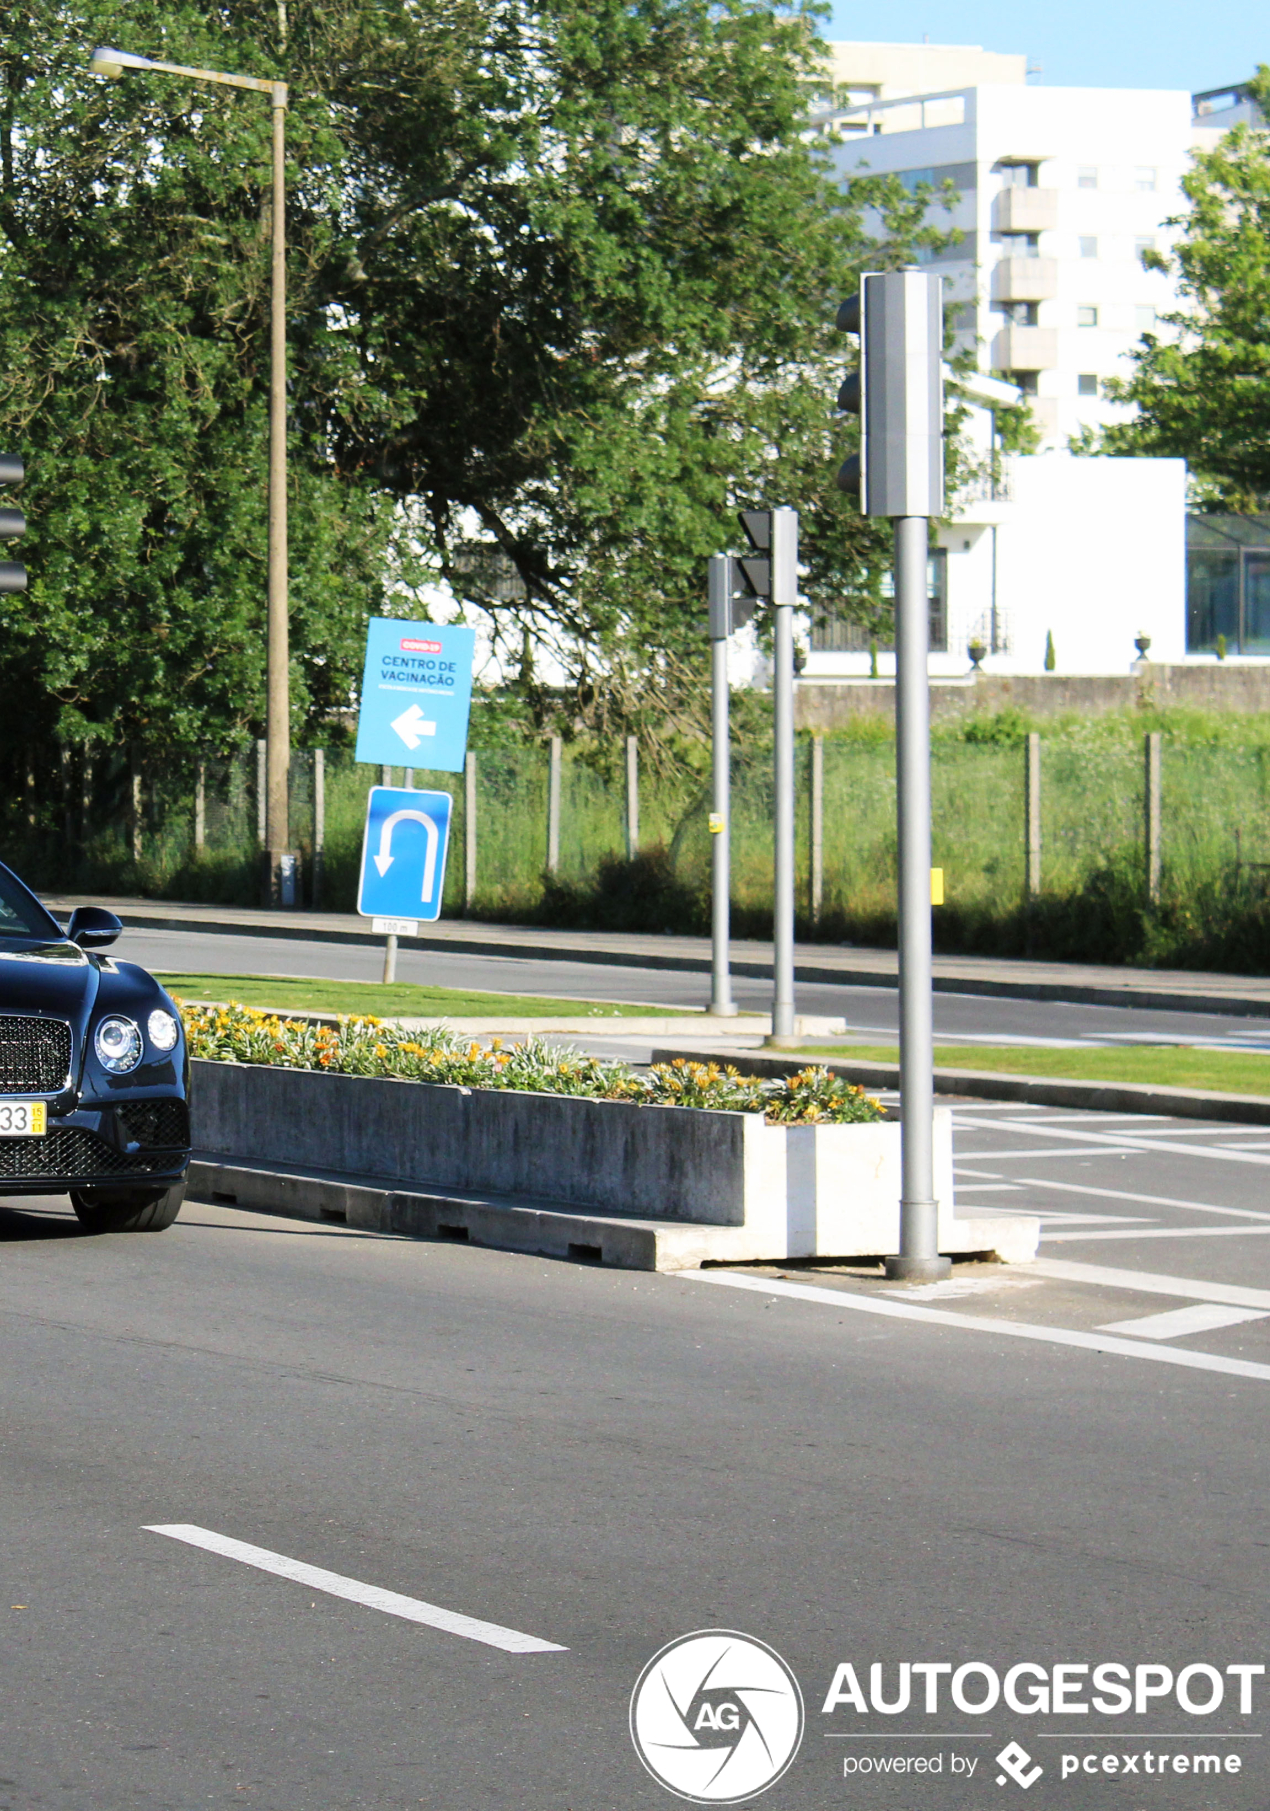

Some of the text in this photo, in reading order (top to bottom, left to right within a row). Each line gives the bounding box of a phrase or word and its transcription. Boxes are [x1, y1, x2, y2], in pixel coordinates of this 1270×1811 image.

[402, 641, 440, 652] COVID-19
[382, 655, 457, 673] CENTRO DE
[381, 670, 455, 687] VACINAÇÃO
[383, 922, 408, 933] 100 m
[32, 1108, 42, 1116] 15
